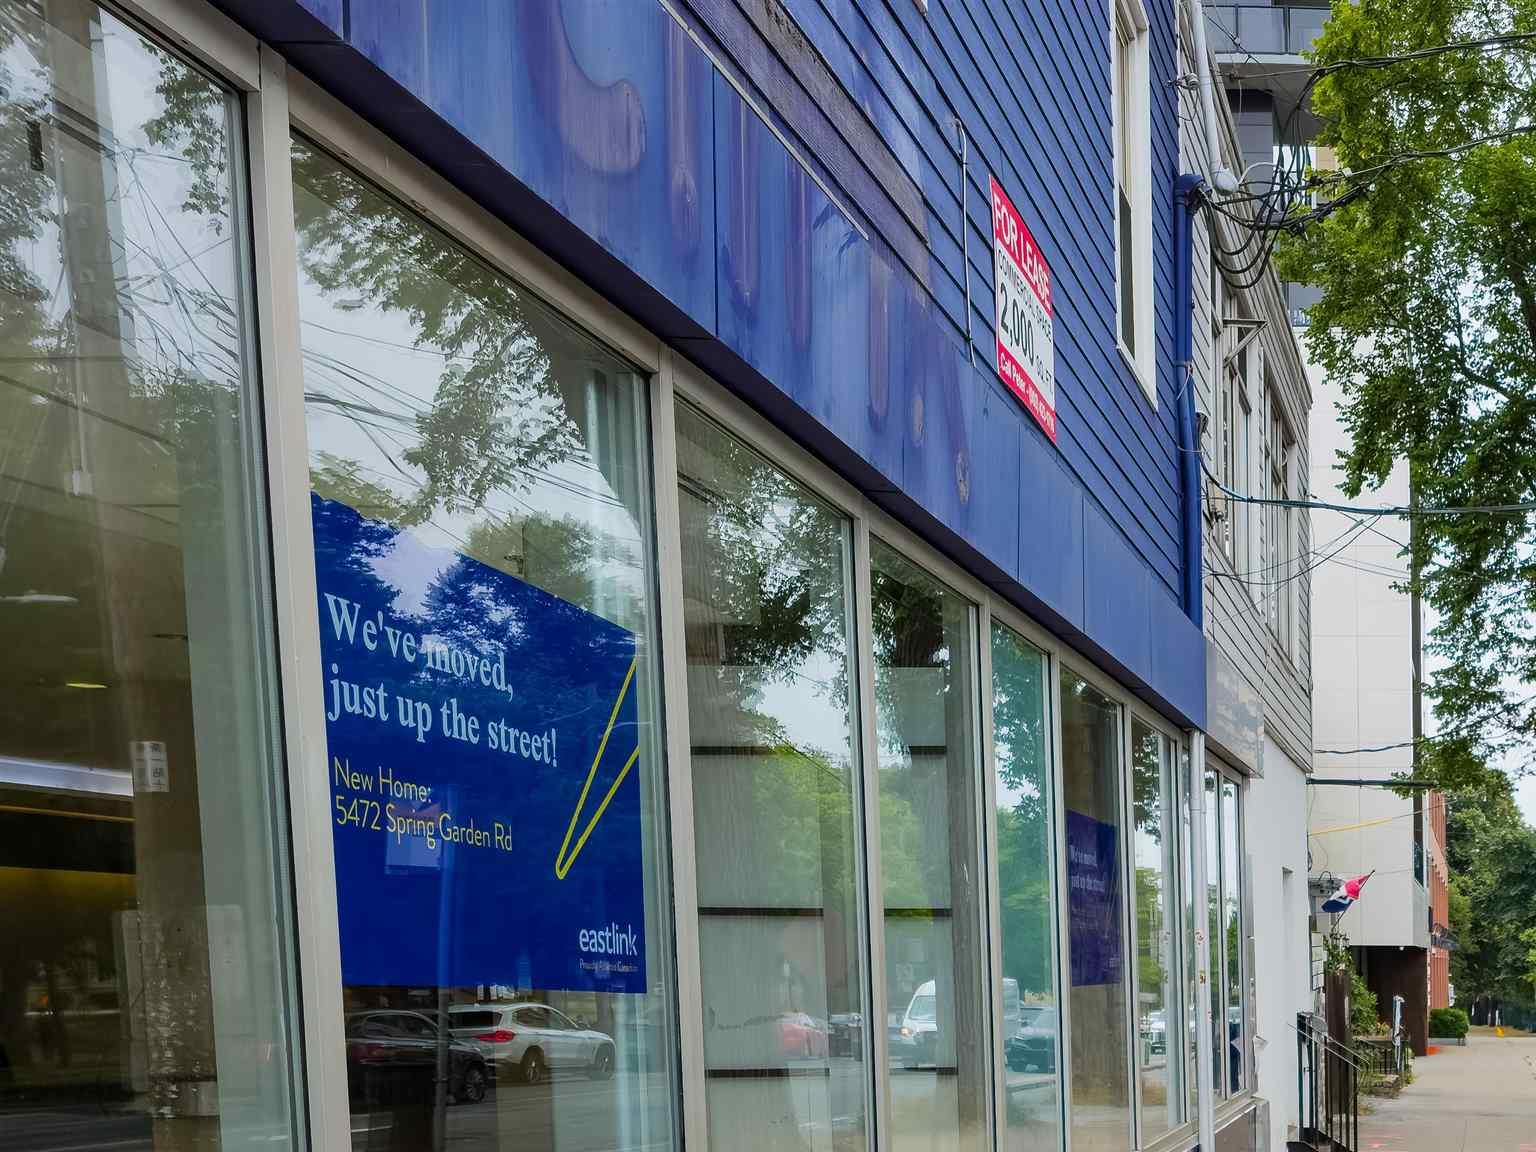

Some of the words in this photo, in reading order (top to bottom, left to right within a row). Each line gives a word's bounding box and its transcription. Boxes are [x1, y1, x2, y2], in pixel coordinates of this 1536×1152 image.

[993, 193, 1019, 261] FOR
[1021, 232, 1052, 312] LEASE
[1000, 281, 1034, 366] 2,000
[324, 593, 417, 662] We've
[427, 637, 513, 701] moved,
[327, 664, 389, 722] just
[397, 696, 433, 743] up
[440, 698, 480, 745] the
[488, 719, 558, 767] street!
[334, 757, 374, 791] New
[379, 767, 432, 803] Home:
[335, 796, 381, 832] 5472
[386, 805, 436, 849] Spring
[439, 813, 491, 848] Garden
[495, 822, 513, 852] Rd
[579, 922, 638, 956] eastlink
